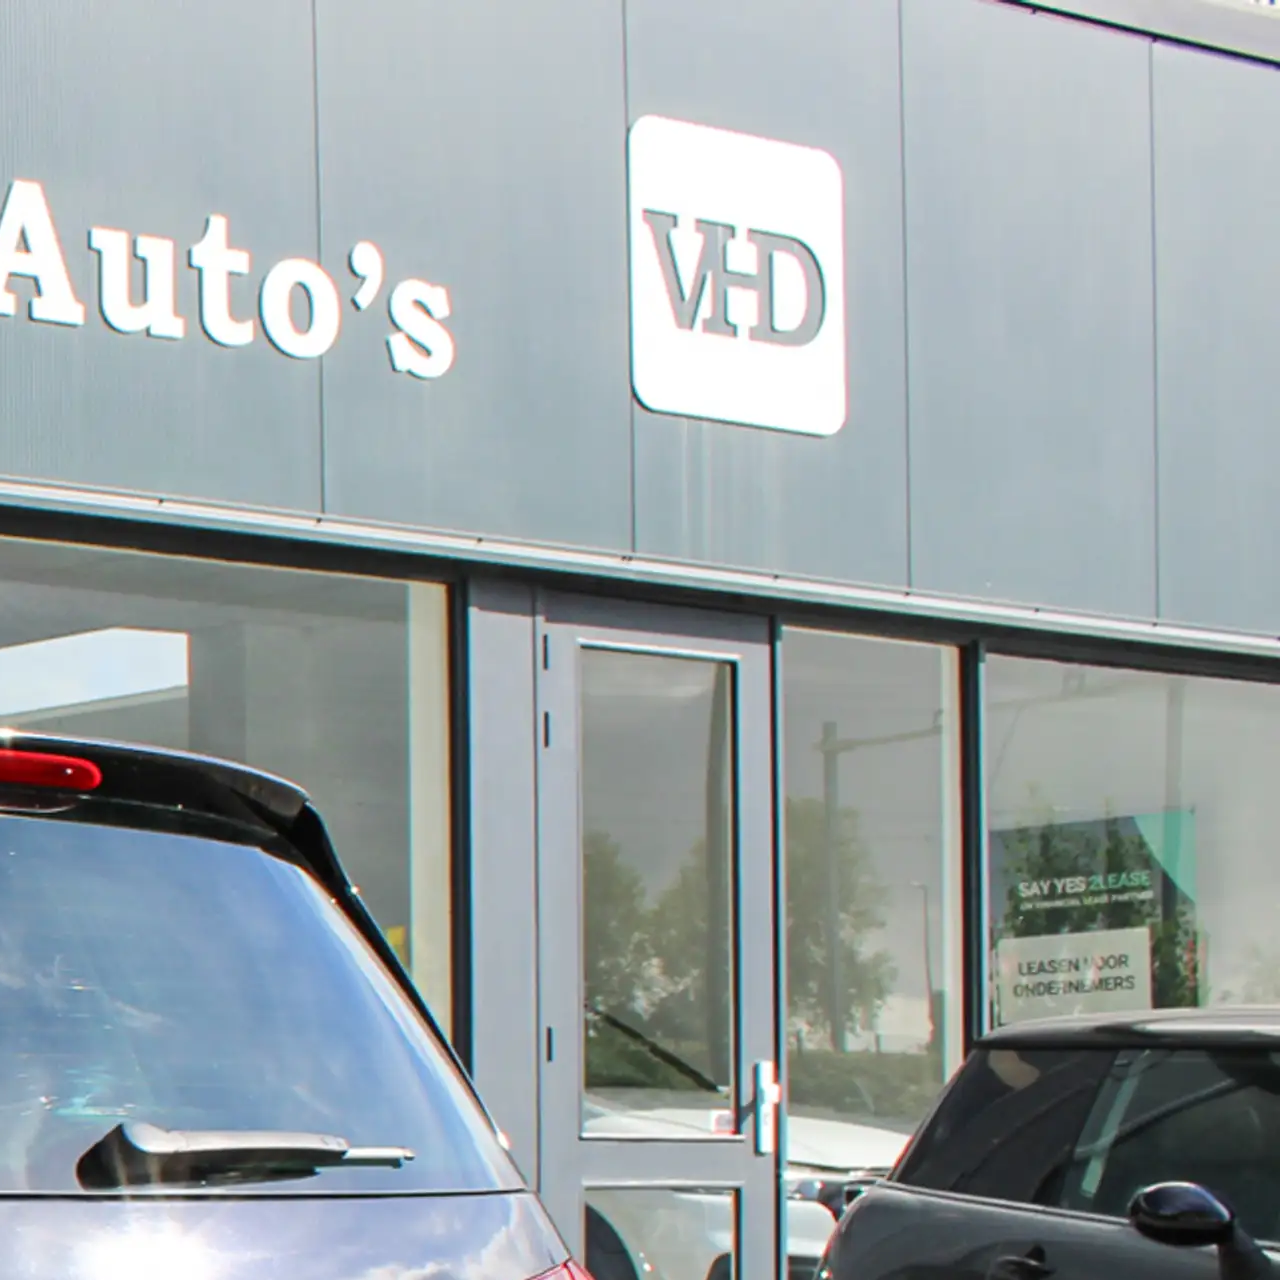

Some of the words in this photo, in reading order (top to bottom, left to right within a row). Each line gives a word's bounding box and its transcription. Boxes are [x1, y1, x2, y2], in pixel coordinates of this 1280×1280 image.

[641, 208, 827, 349] VHD
[1018, 879, 1052, 898] SAY
[1053, 876, 1086, 894] YES
[1017, 957, 1080, 976] LEASEN
